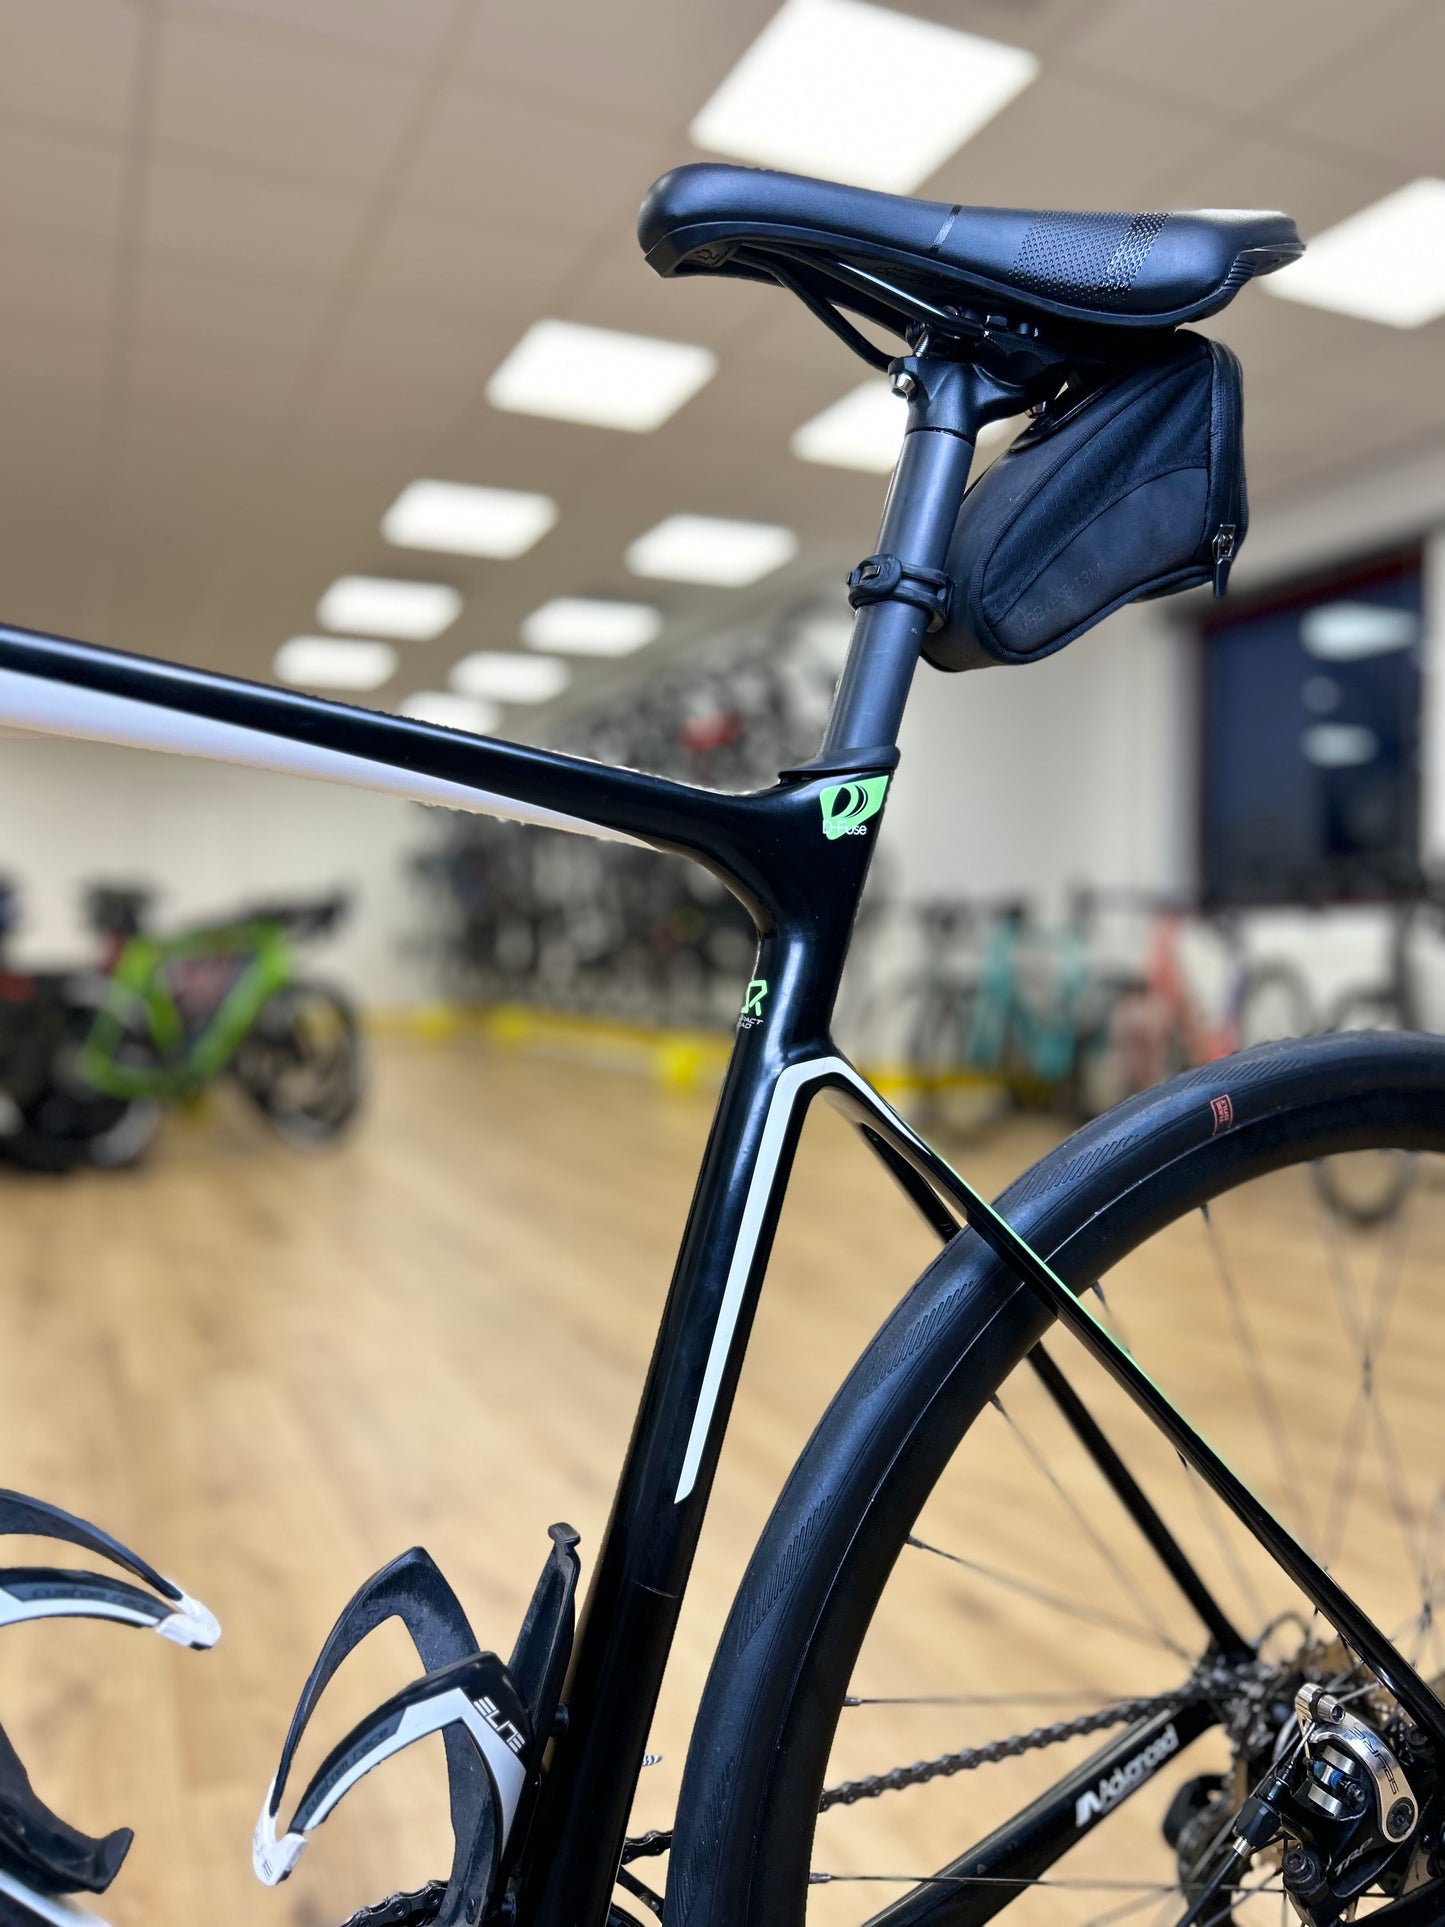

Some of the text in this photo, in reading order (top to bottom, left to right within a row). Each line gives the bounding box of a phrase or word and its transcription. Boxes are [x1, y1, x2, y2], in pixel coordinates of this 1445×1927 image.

[822, 818, 868, 836] D-Fuse
[473, 1696, 527, 1754] ELITE
[1350, 1726, 1400, 1795] SPYRE
[1334, 1836, 1374, 1877] TRP
